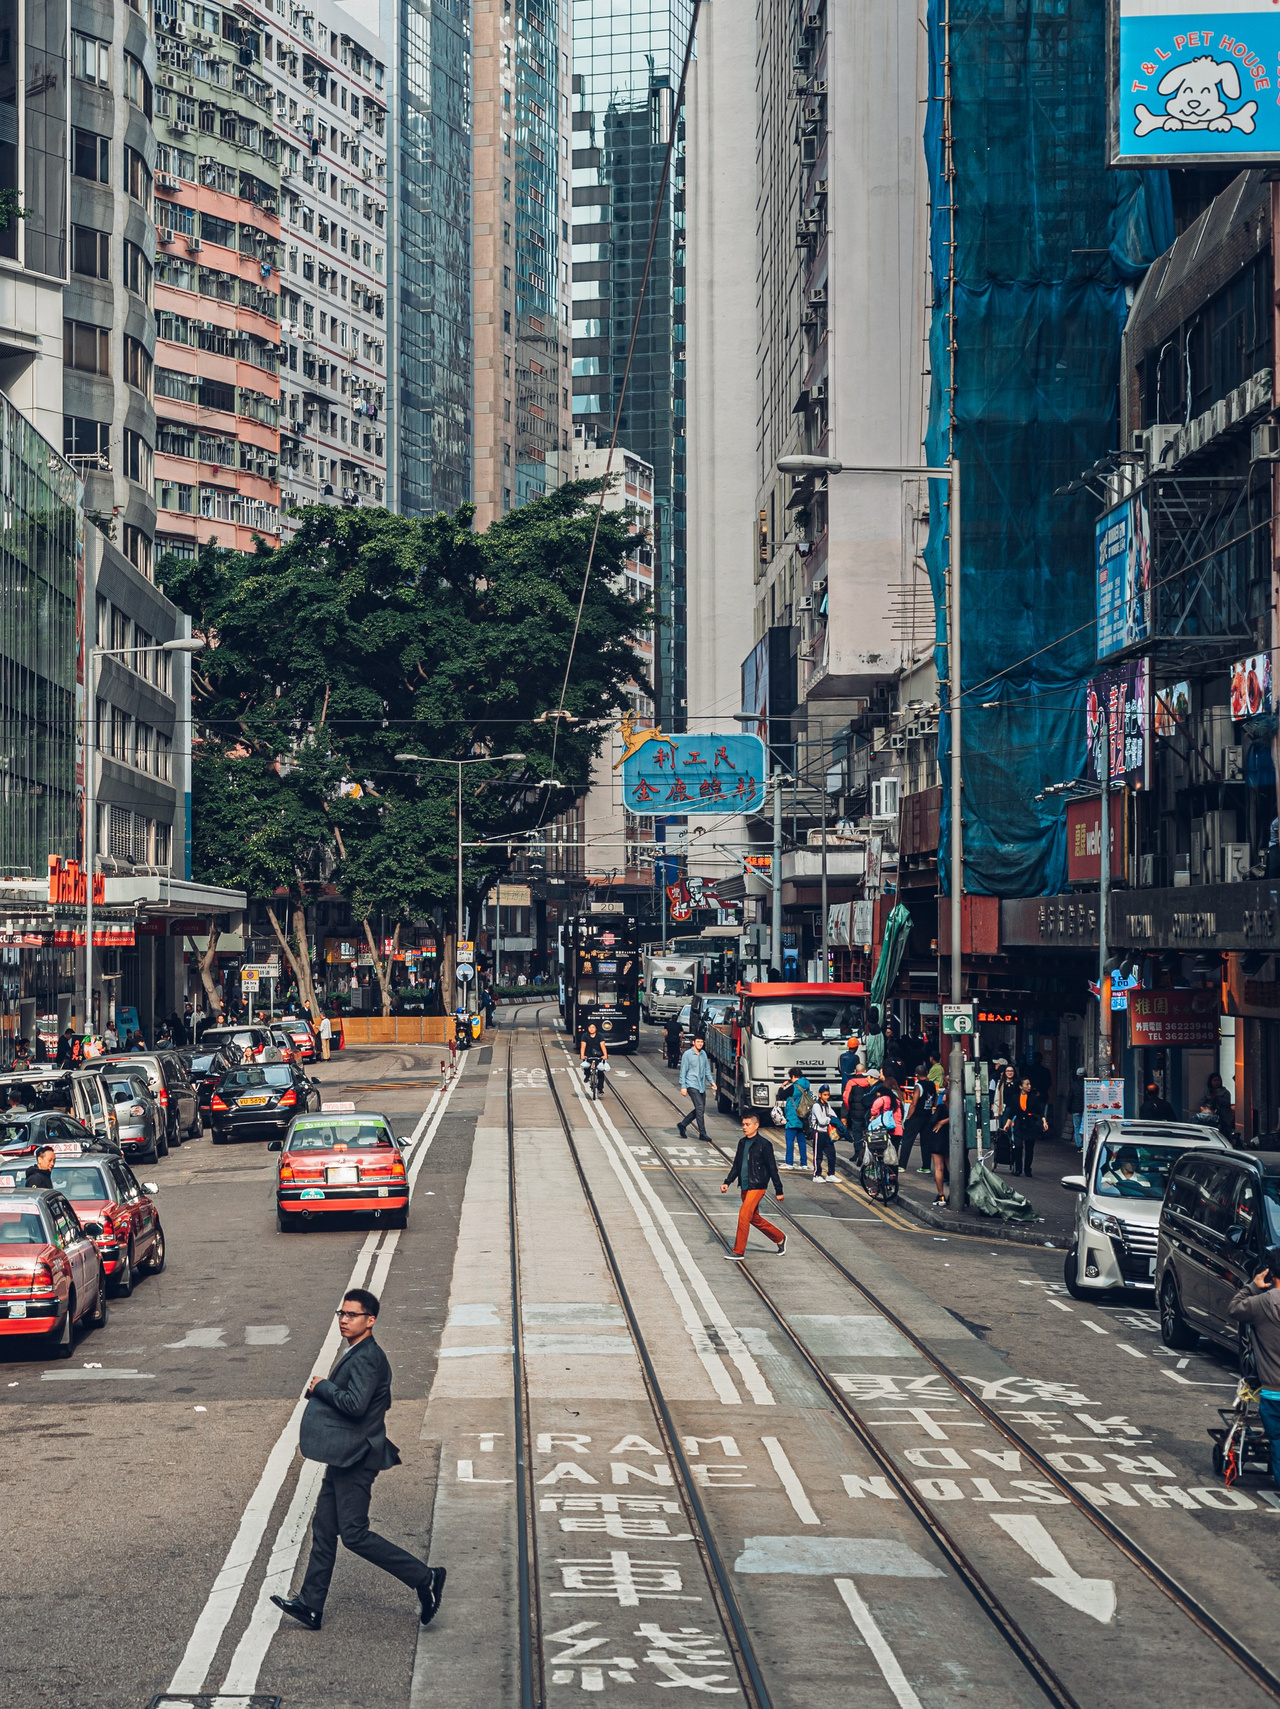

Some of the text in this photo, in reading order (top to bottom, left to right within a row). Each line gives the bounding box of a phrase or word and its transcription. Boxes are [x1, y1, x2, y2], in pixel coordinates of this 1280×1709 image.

[1131, 31, 1271, 93] T & L PET HOUSE
[652, 746, 735, 769] 利工民
[600, 903, 614, 911] 20
[1148, 1032, 1162, 1040] TEL
[461, 1432, 742, 1456] TRAM
[457, 1460, 756, 1487] LANE
[904, 1447, 1177, 1478] ROAD
